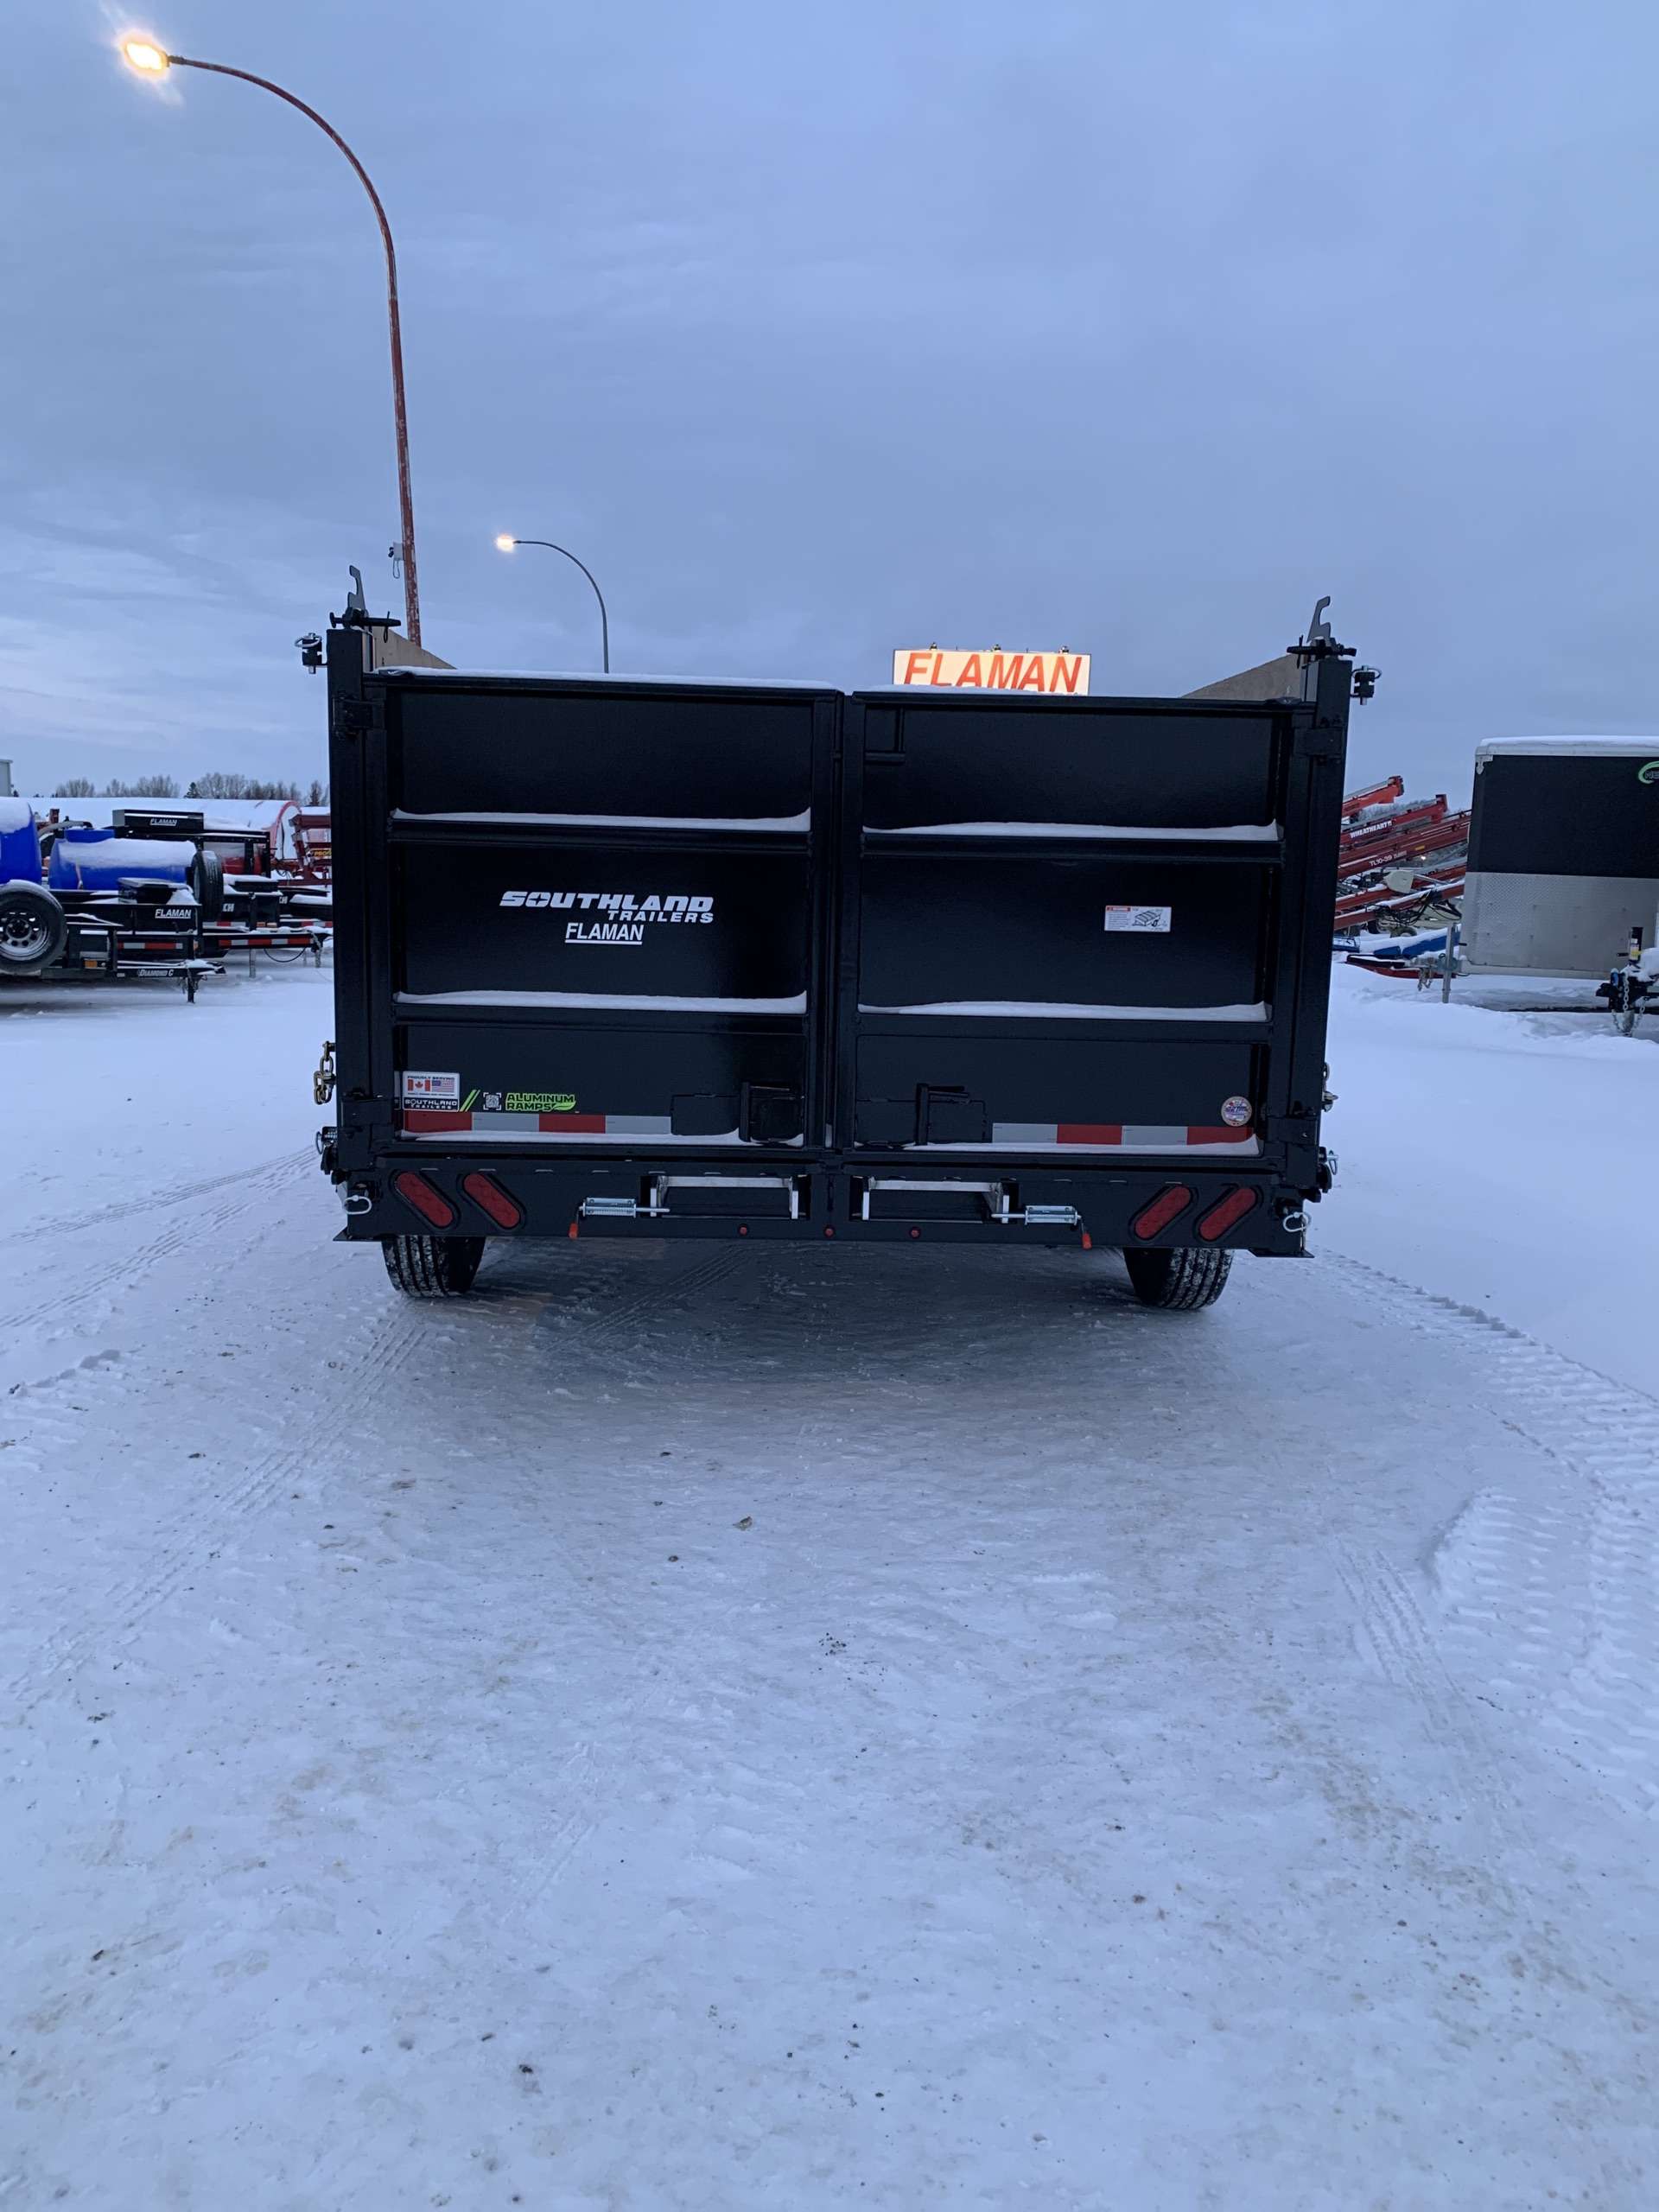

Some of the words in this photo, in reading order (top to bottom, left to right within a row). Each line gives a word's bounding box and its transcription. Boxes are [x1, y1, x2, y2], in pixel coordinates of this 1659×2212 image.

[904, 652, 1083, 693] FLAMAN
[150, 817, 178, 826] FLAMAN
[499, 891, 714, 912] SOUTHLAND
[155, 908, 192, 918] FLAMAN
[607, 910, 715, 924] TRAILERS
[565, 922, 644, 942] FLAMAN
[506, 1093, 575, 1103] ALUMINUM
[506, 1103, 551, 1111] RAMPS
